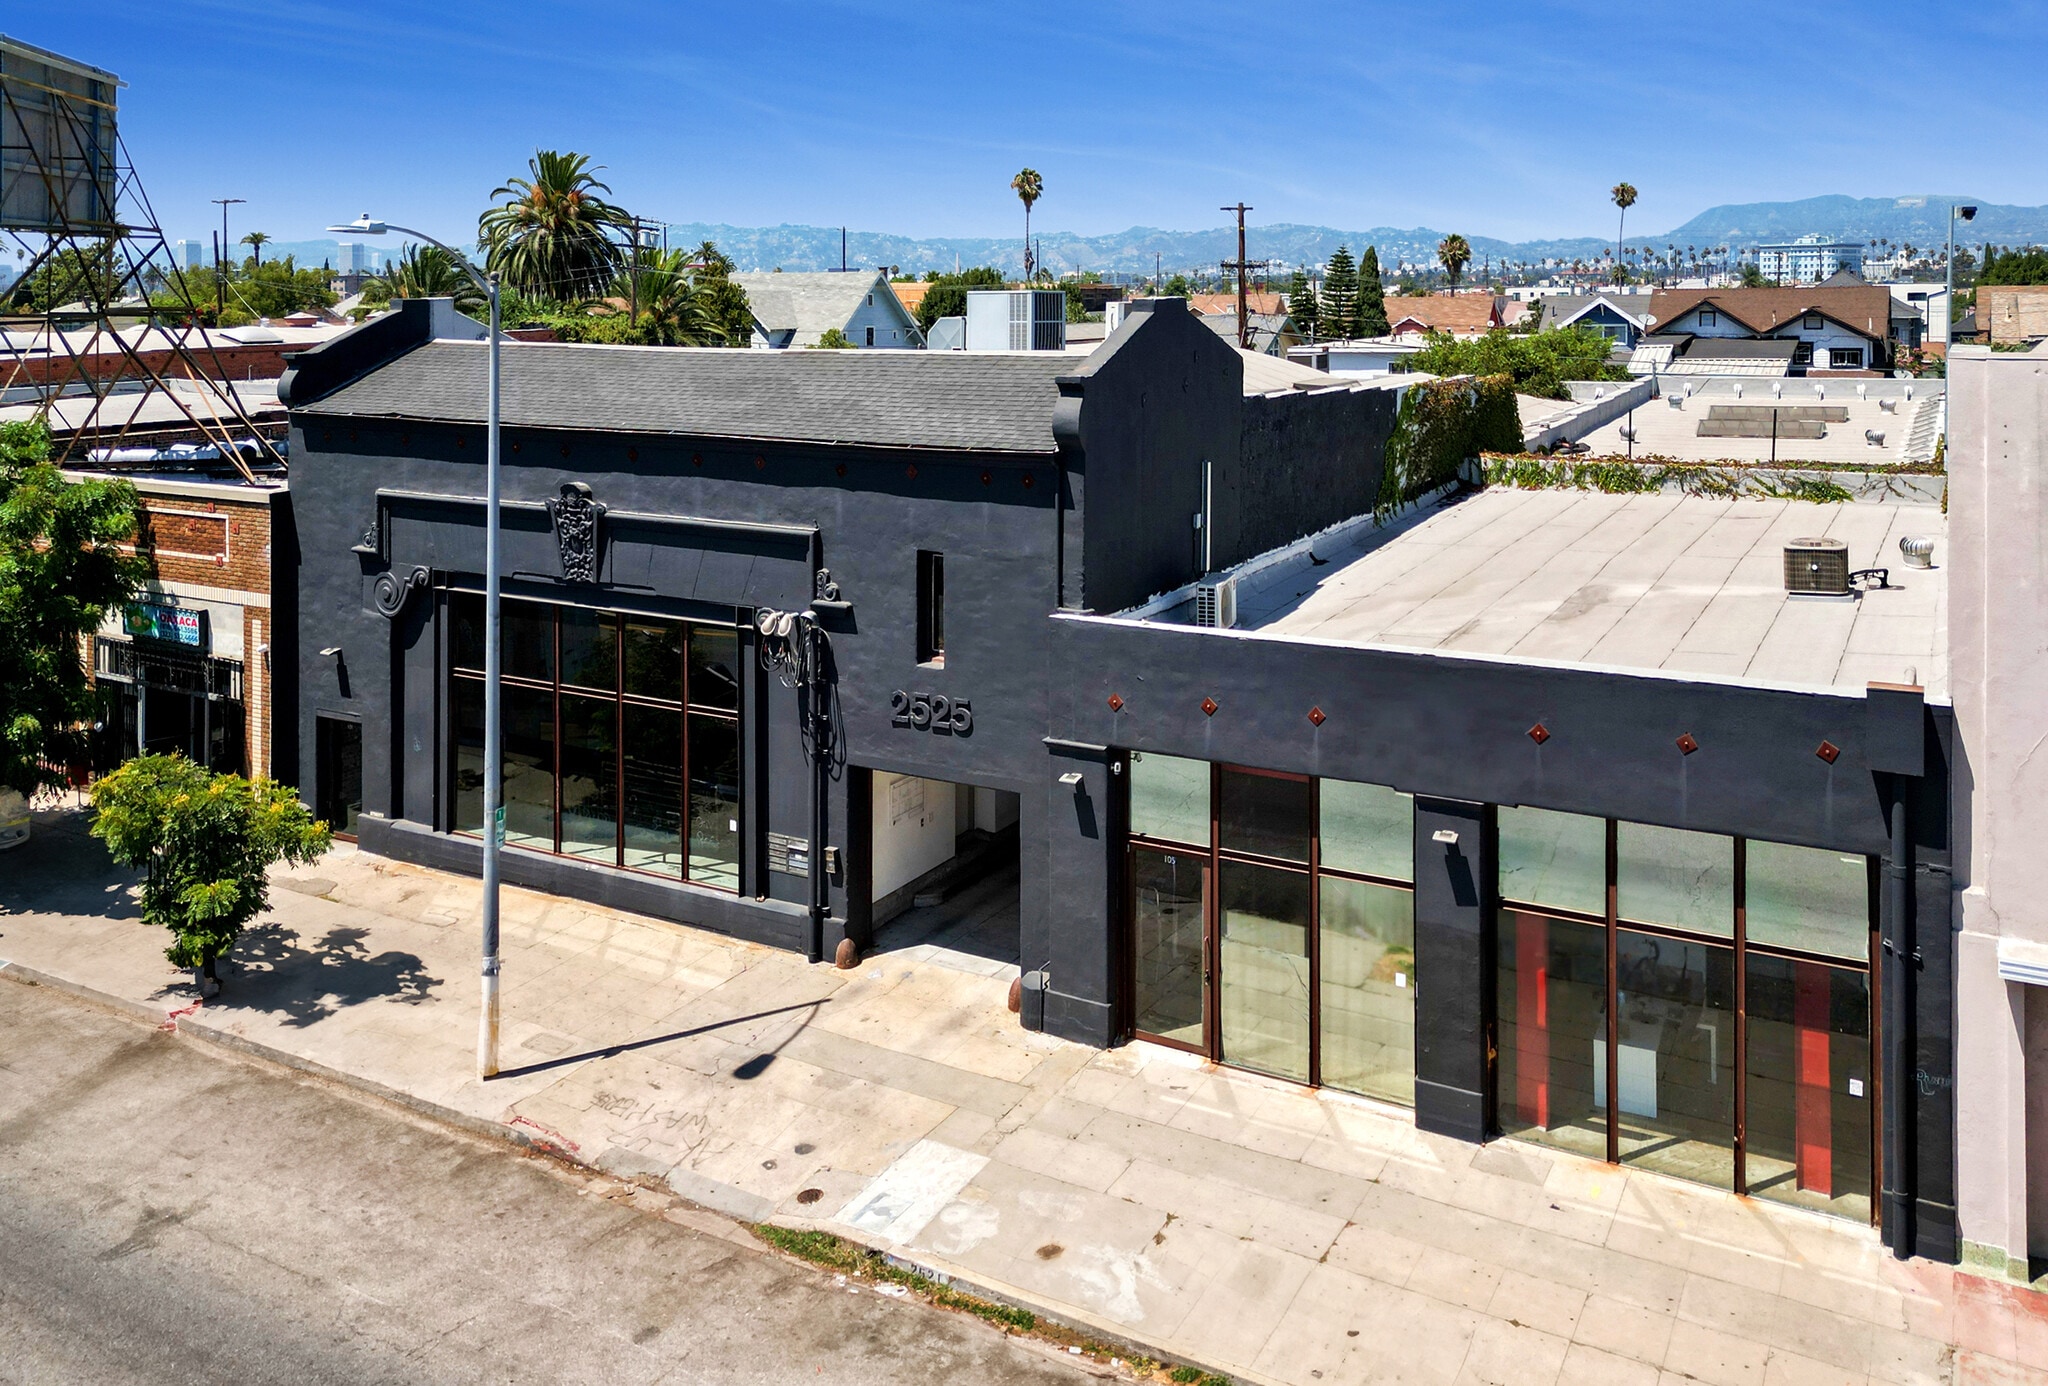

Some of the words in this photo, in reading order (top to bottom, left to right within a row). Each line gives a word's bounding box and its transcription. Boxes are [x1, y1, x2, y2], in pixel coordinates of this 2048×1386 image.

[160, 613, 198, 627] OAXACA
[891, 689, 973, 736] 2525
[1164, 855, 1176, 864] 105
